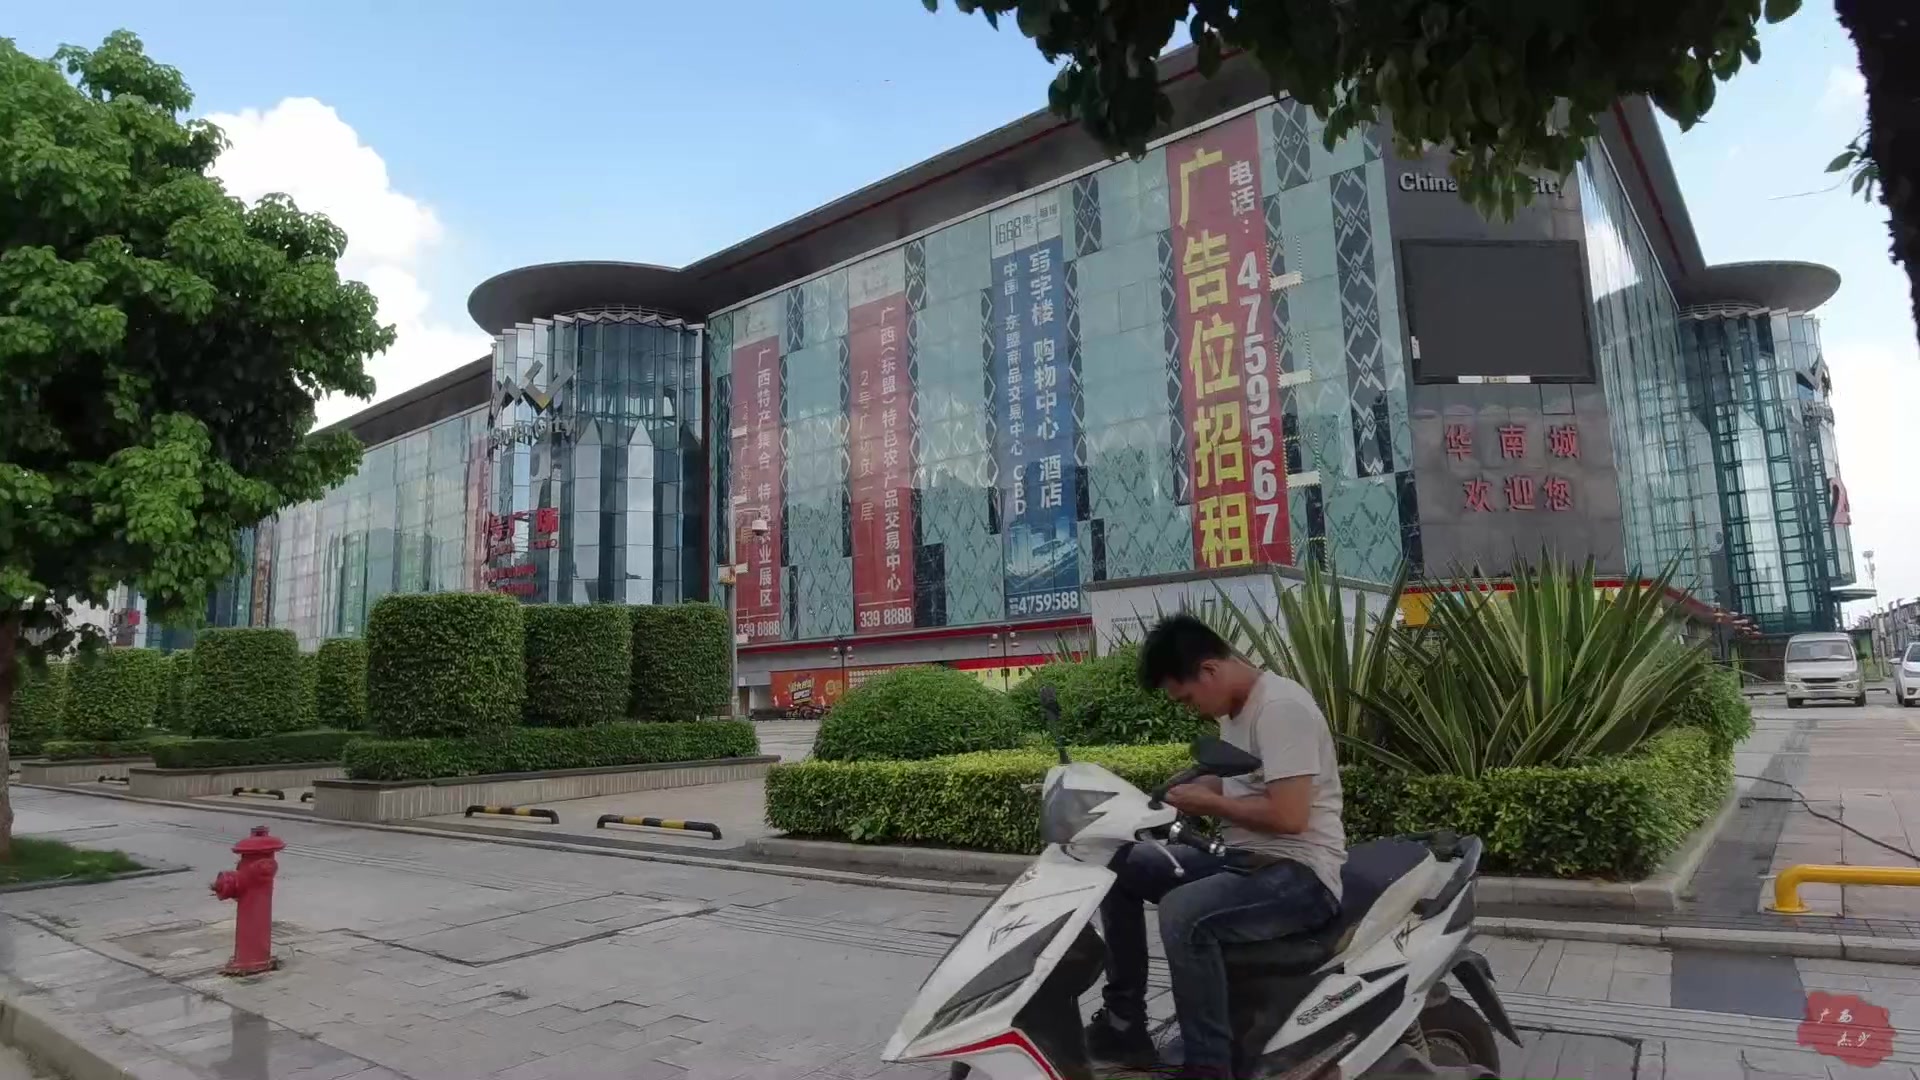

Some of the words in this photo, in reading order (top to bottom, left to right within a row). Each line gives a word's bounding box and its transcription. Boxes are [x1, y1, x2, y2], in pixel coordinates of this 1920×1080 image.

[1400, 172, 1457, 192] China
[1029, 249, 1054, 327] 写字楼
[1179, 147, 1253, 568] 广告位招租
[1033, 338, 1060, 440] 购物中心
[1446, 423, 1580, 461] 华南城
[1013, 465, 1026, 515] CBD
[1038, 454, 1062, 509] 酒店
[1462, 473, 1574, 513] 欢迎您
[860, 609, 880, 628] 339
[884, 606, 912, 626] 8888
[1019, 590, 1079, 615] 4759588
[757, 620, 780, 637] 8888
